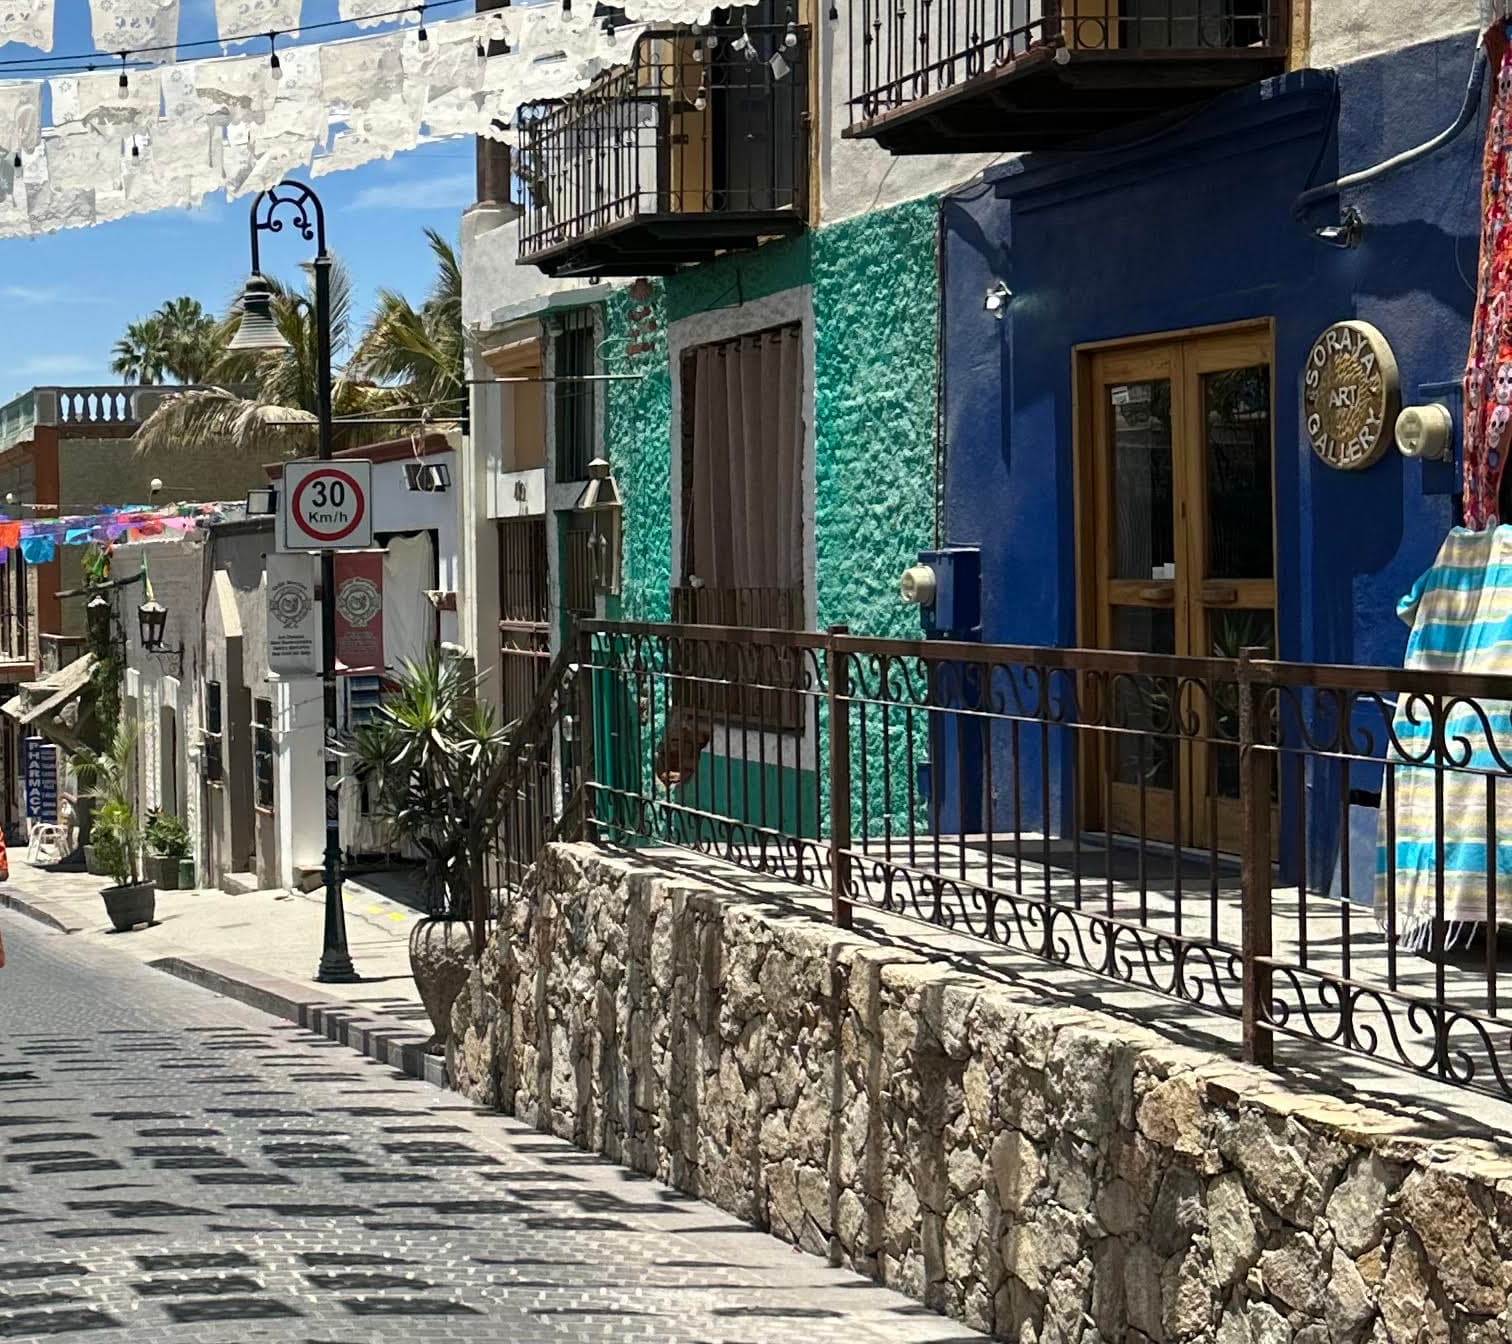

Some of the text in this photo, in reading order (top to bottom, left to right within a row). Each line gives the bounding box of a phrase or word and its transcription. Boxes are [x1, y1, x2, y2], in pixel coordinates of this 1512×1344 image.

[1329, 385, 1358, 408] ART
[1307, 407, 1382, 467] GALLERY
[312, 480, 345, 508] 30
[309, 511, 348, 523] Km/h
[28, 742, 41, 815] PHARMACY
